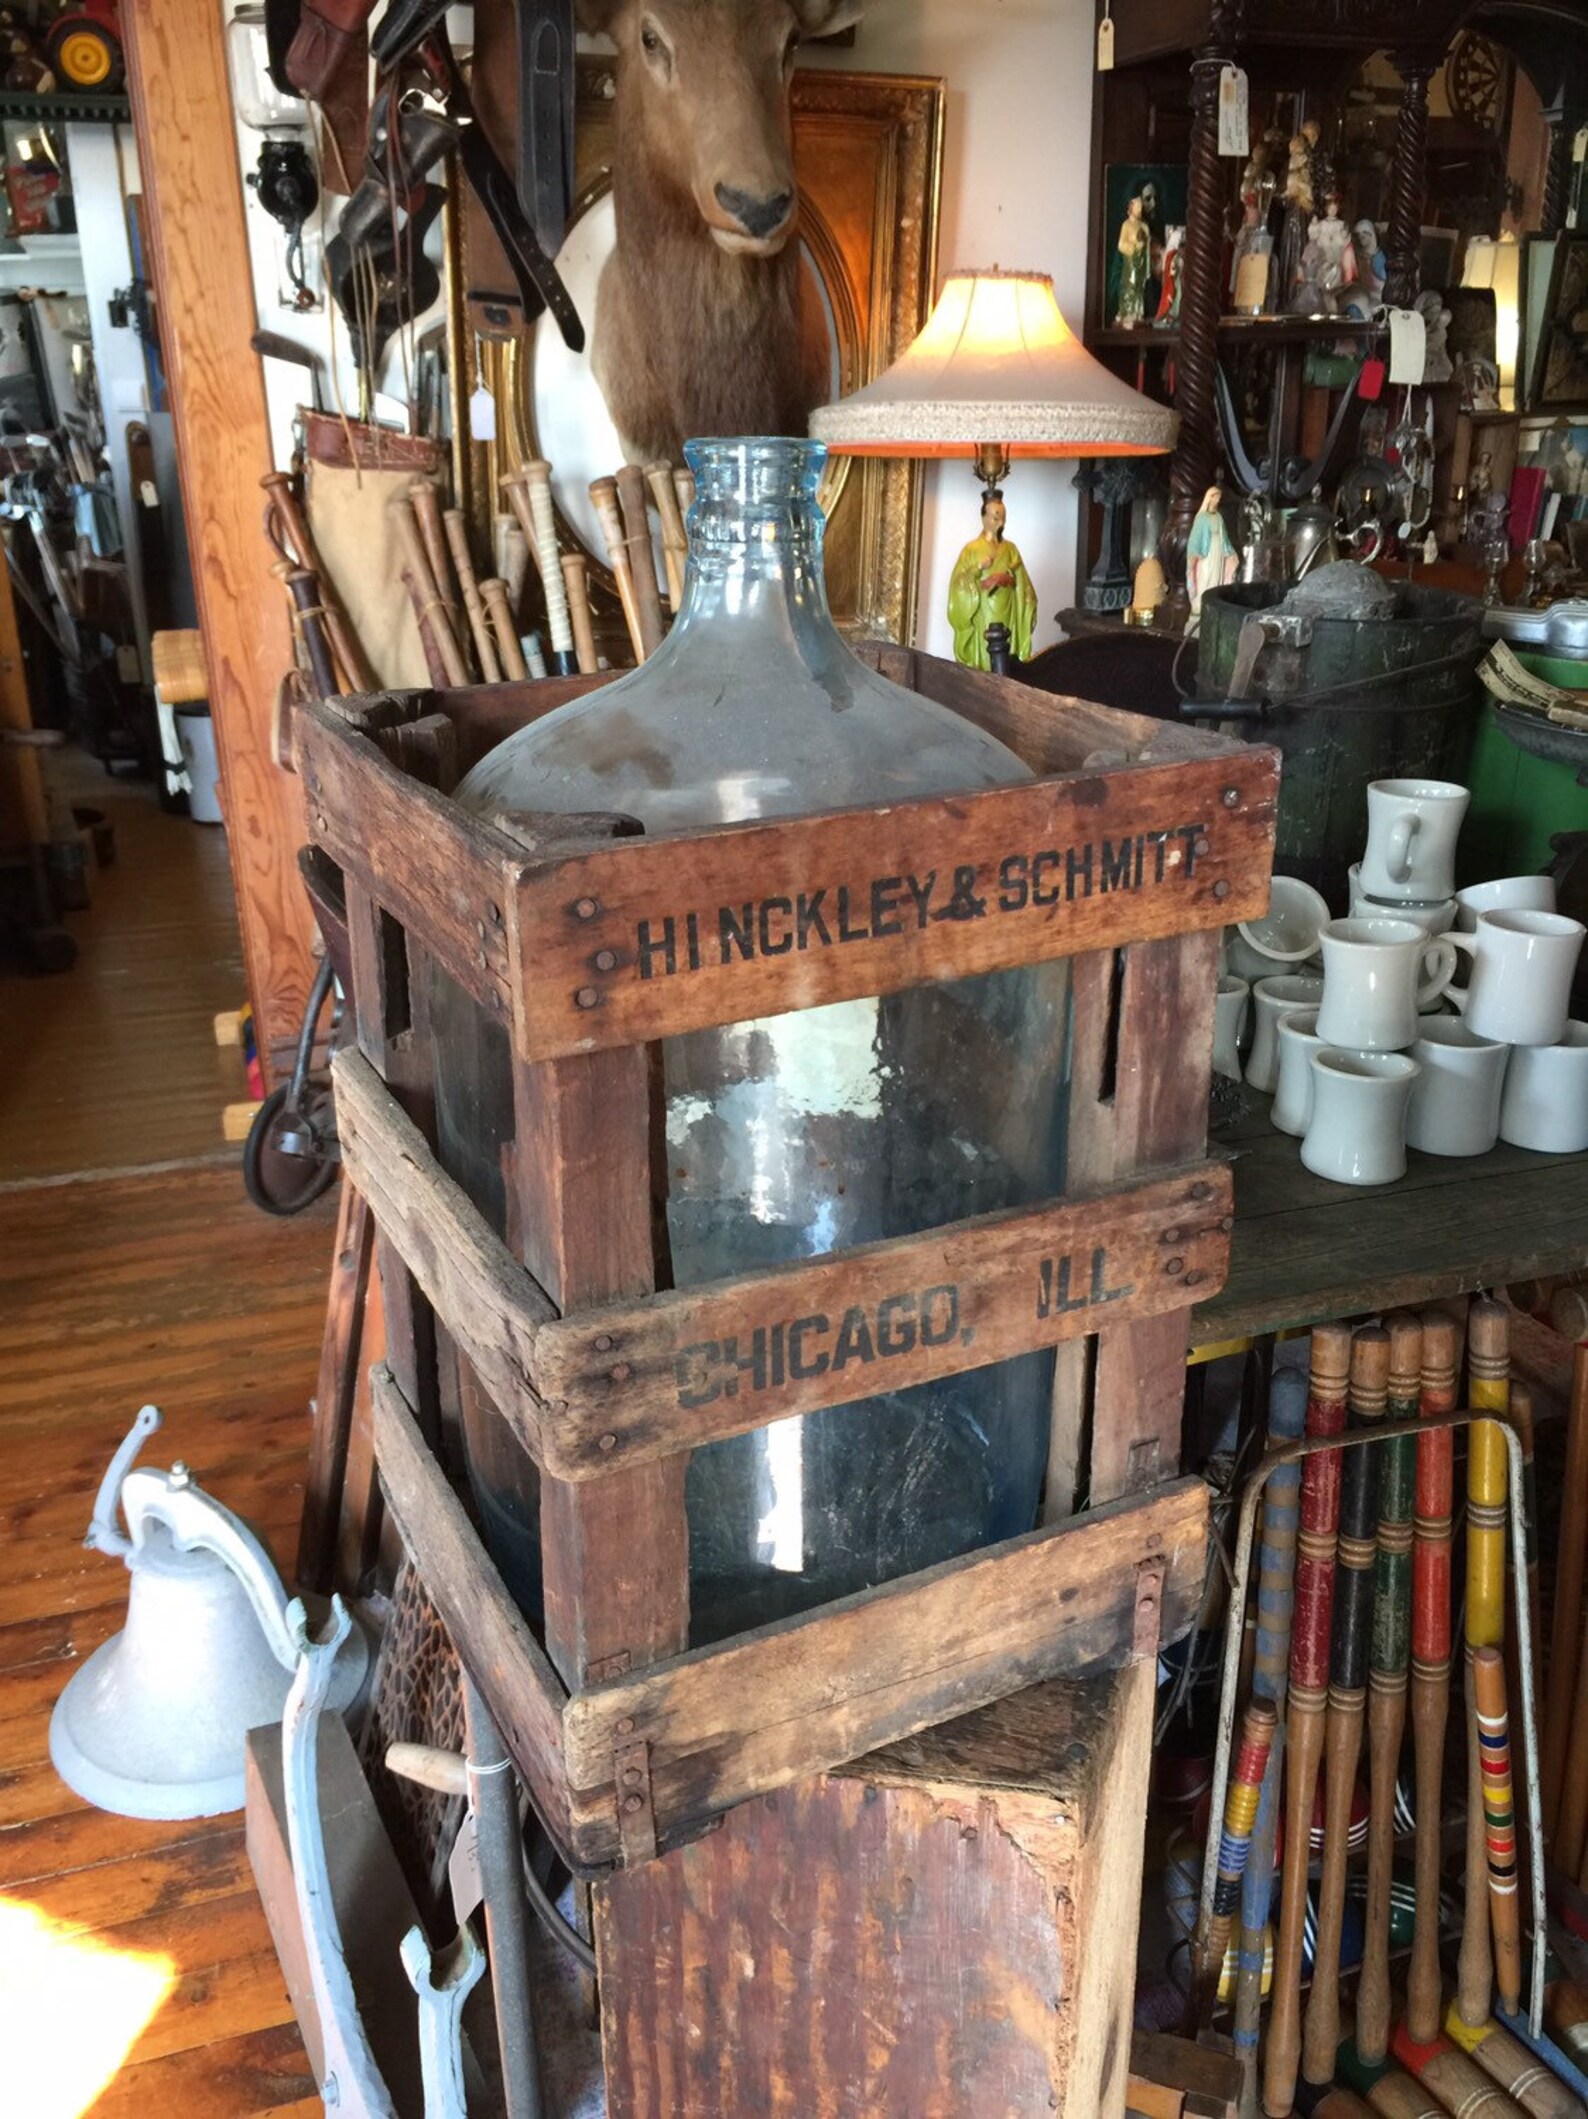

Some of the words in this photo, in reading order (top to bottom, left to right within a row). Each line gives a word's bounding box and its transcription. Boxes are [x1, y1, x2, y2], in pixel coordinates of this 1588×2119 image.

[637, 868, 938, 980] HINCKLEY
[930, 864, 988, 922] &
[999, 823, 1205, 912] SCHMITT
[674, 1283, 976, 1410] CHICAGO,
